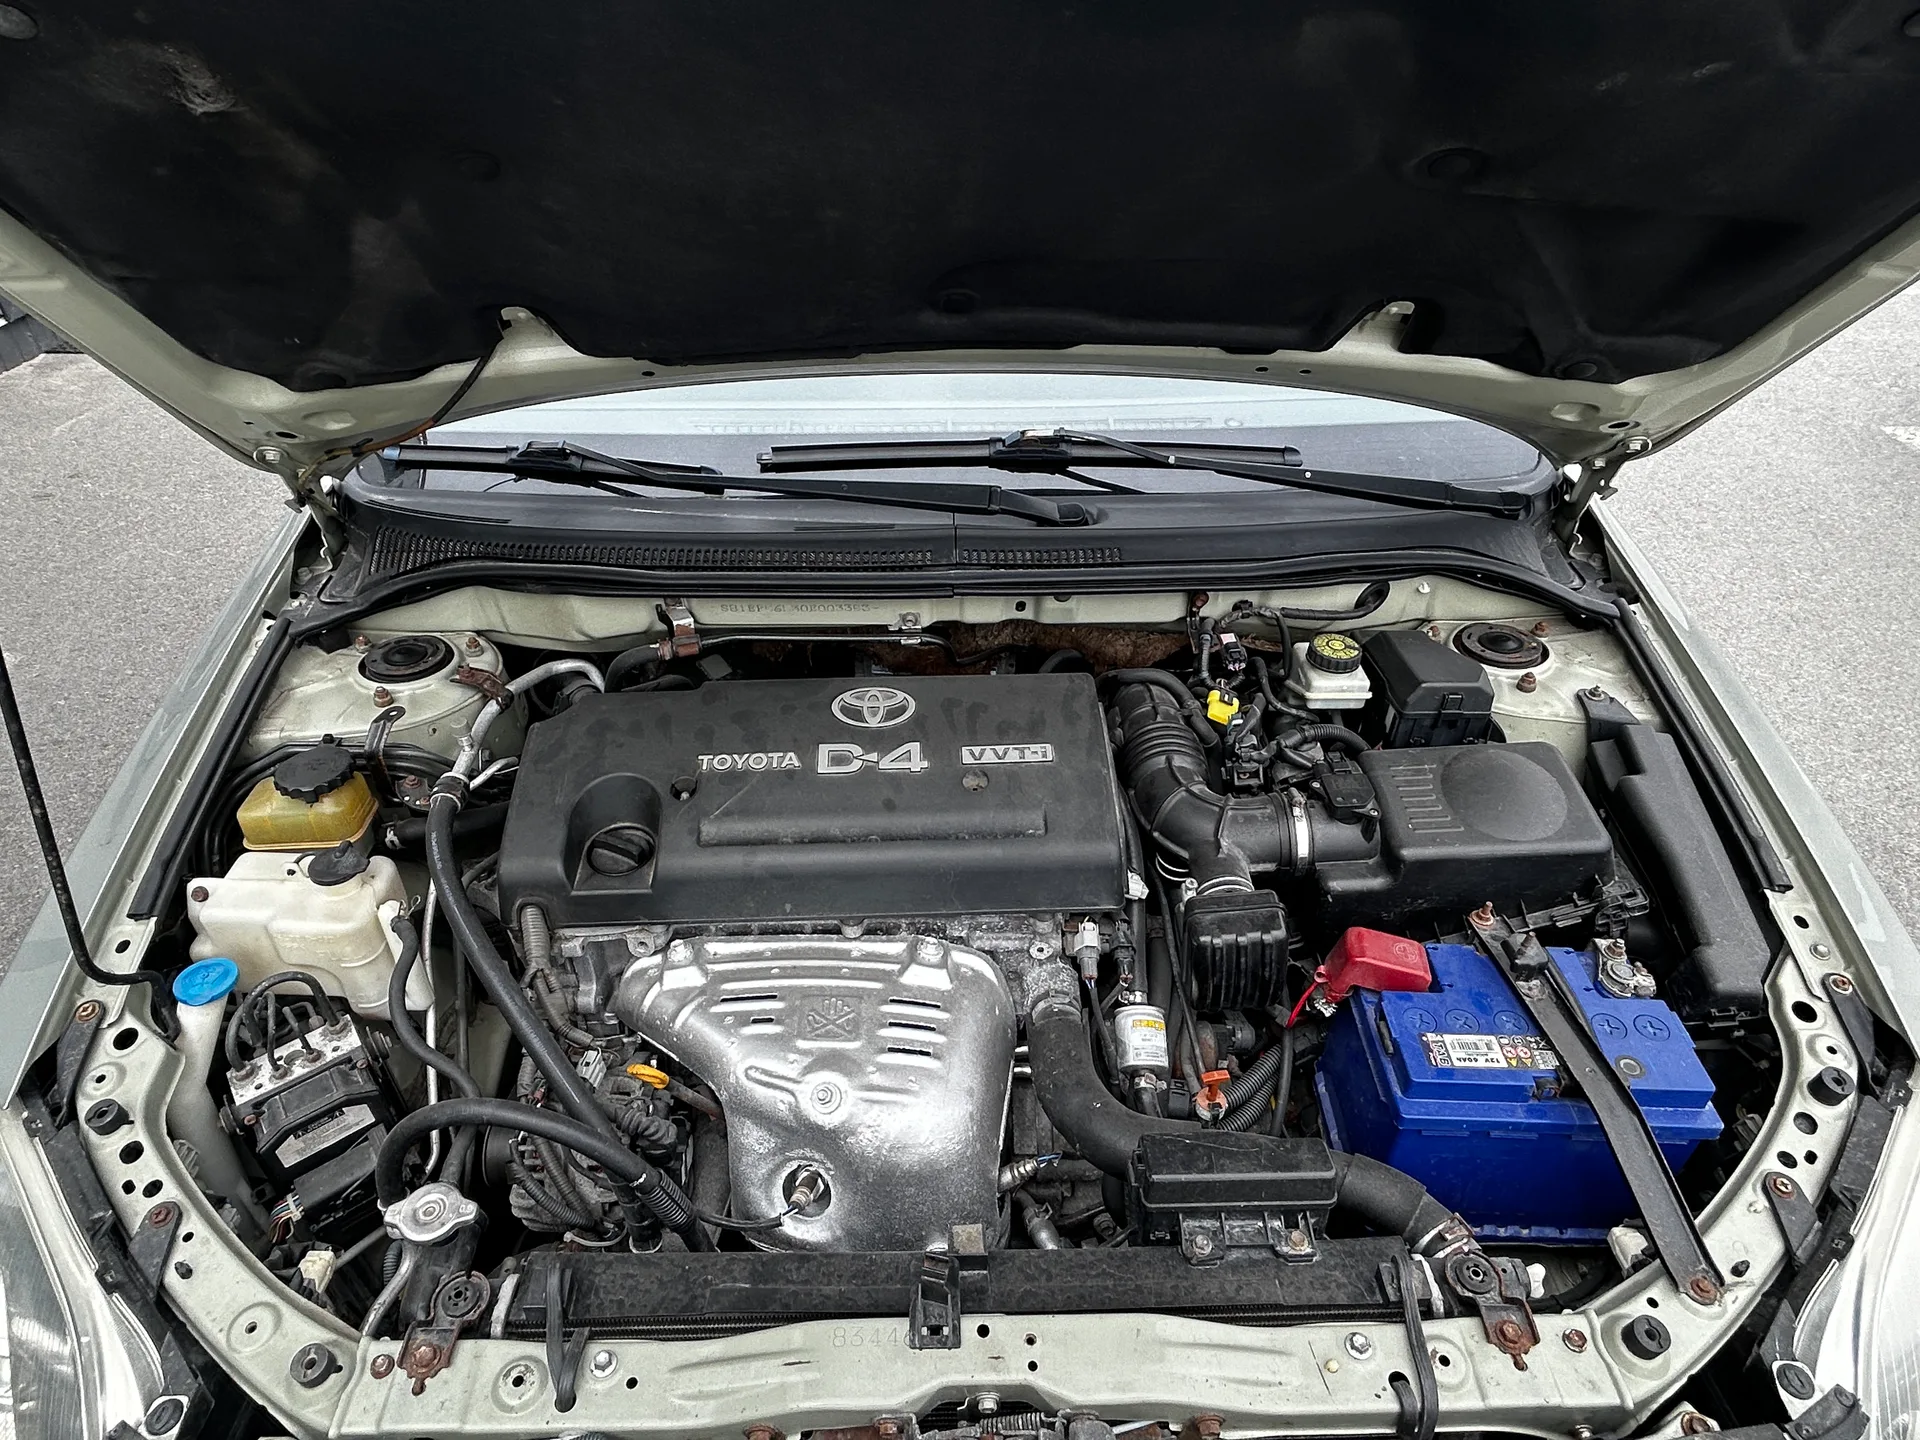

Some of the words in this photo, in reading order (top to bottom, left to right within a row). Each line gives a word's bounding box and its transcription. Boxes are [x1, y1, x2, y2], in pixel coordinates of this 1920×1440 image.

[698, 752, 800, 771] TOYOTA
[817, 742, 928, 774] D-4
[965, 746, 1048, 761] VVT-i
